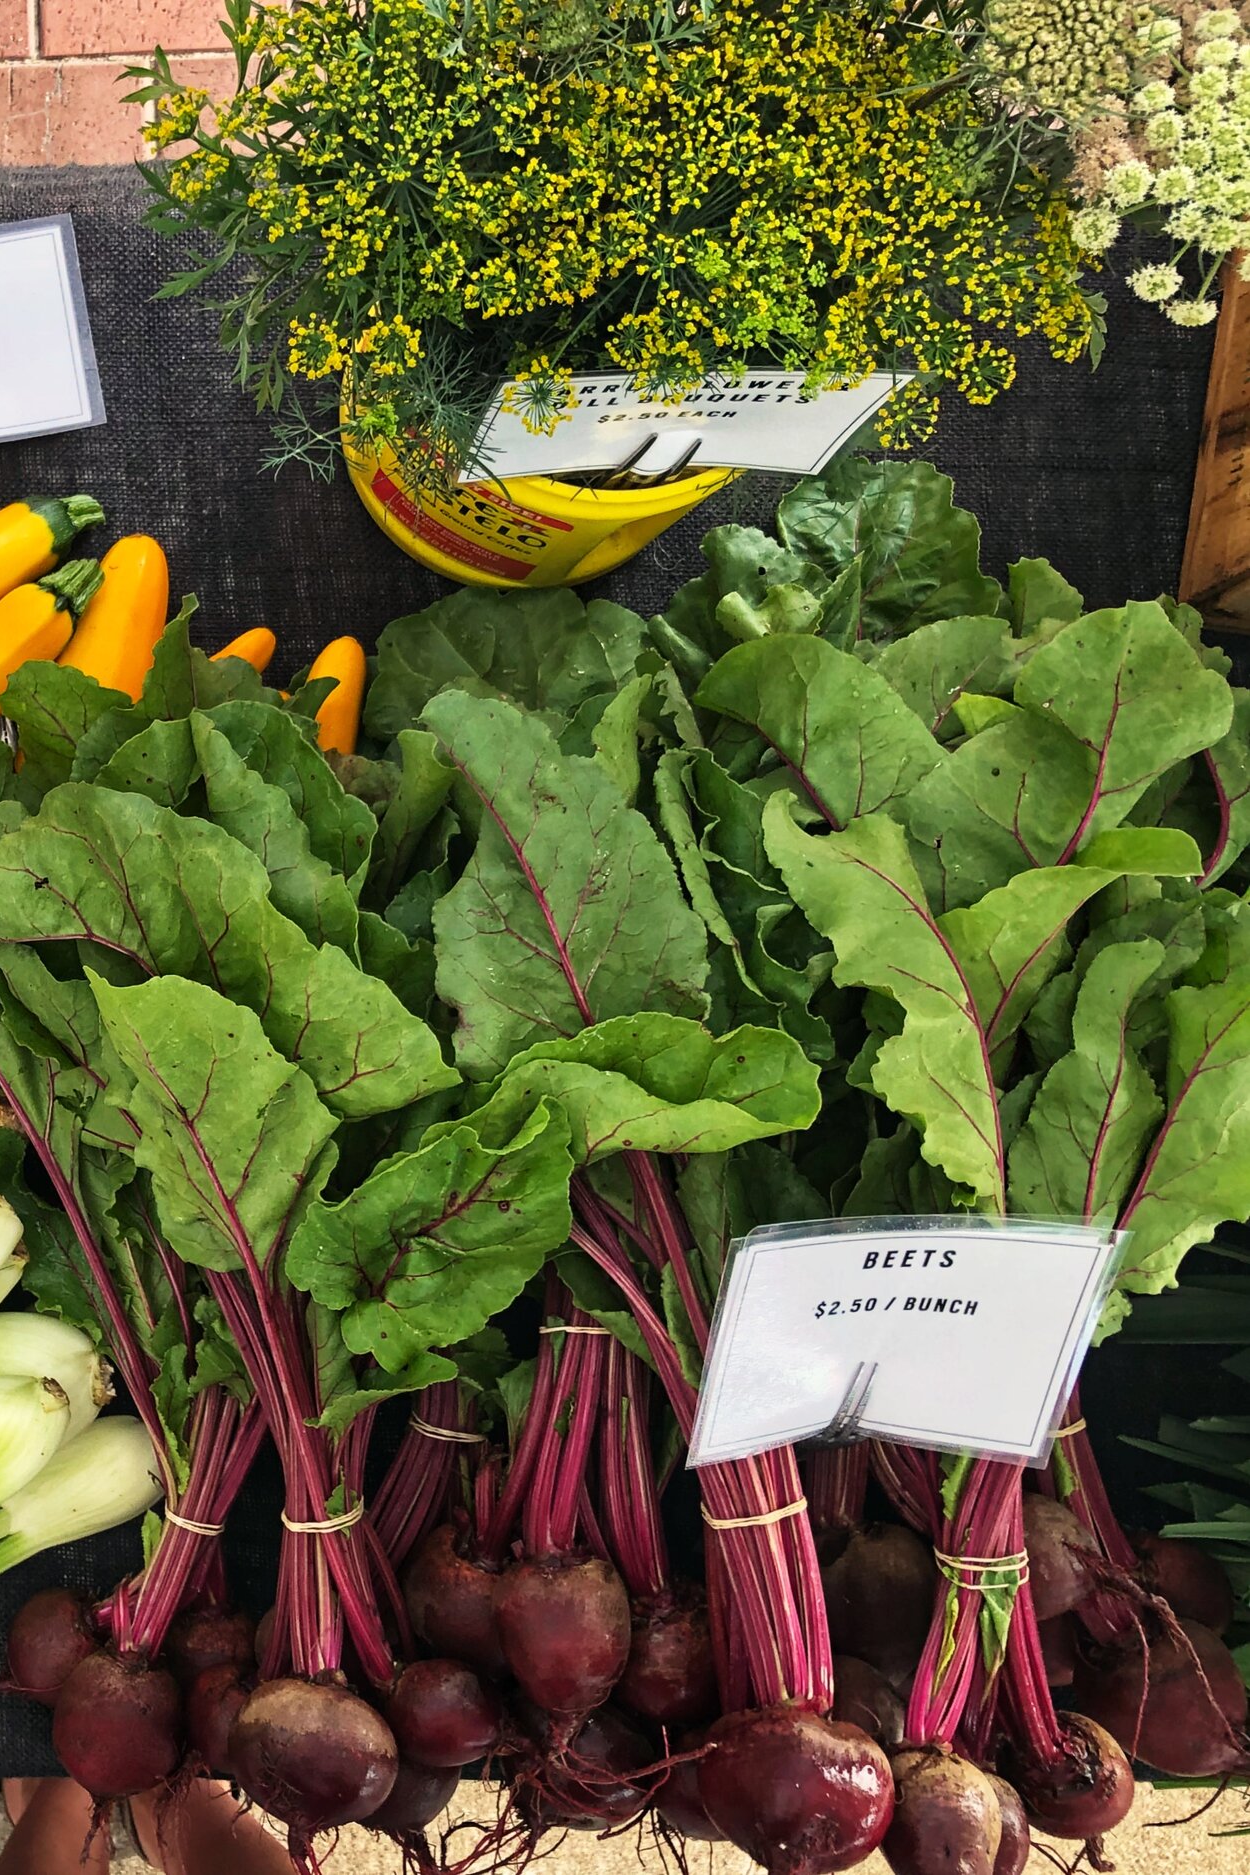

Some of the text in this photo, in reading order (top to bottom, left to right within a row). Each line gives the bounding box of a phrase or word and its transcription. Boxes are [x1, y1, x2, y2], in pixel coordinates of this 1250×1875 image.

[597, 410, 738, 423] $2.50 EACH
[862, 1249, 957, 1270] BEETS
[814, 1296, 979, 1319] $2.50 / BUNCH
